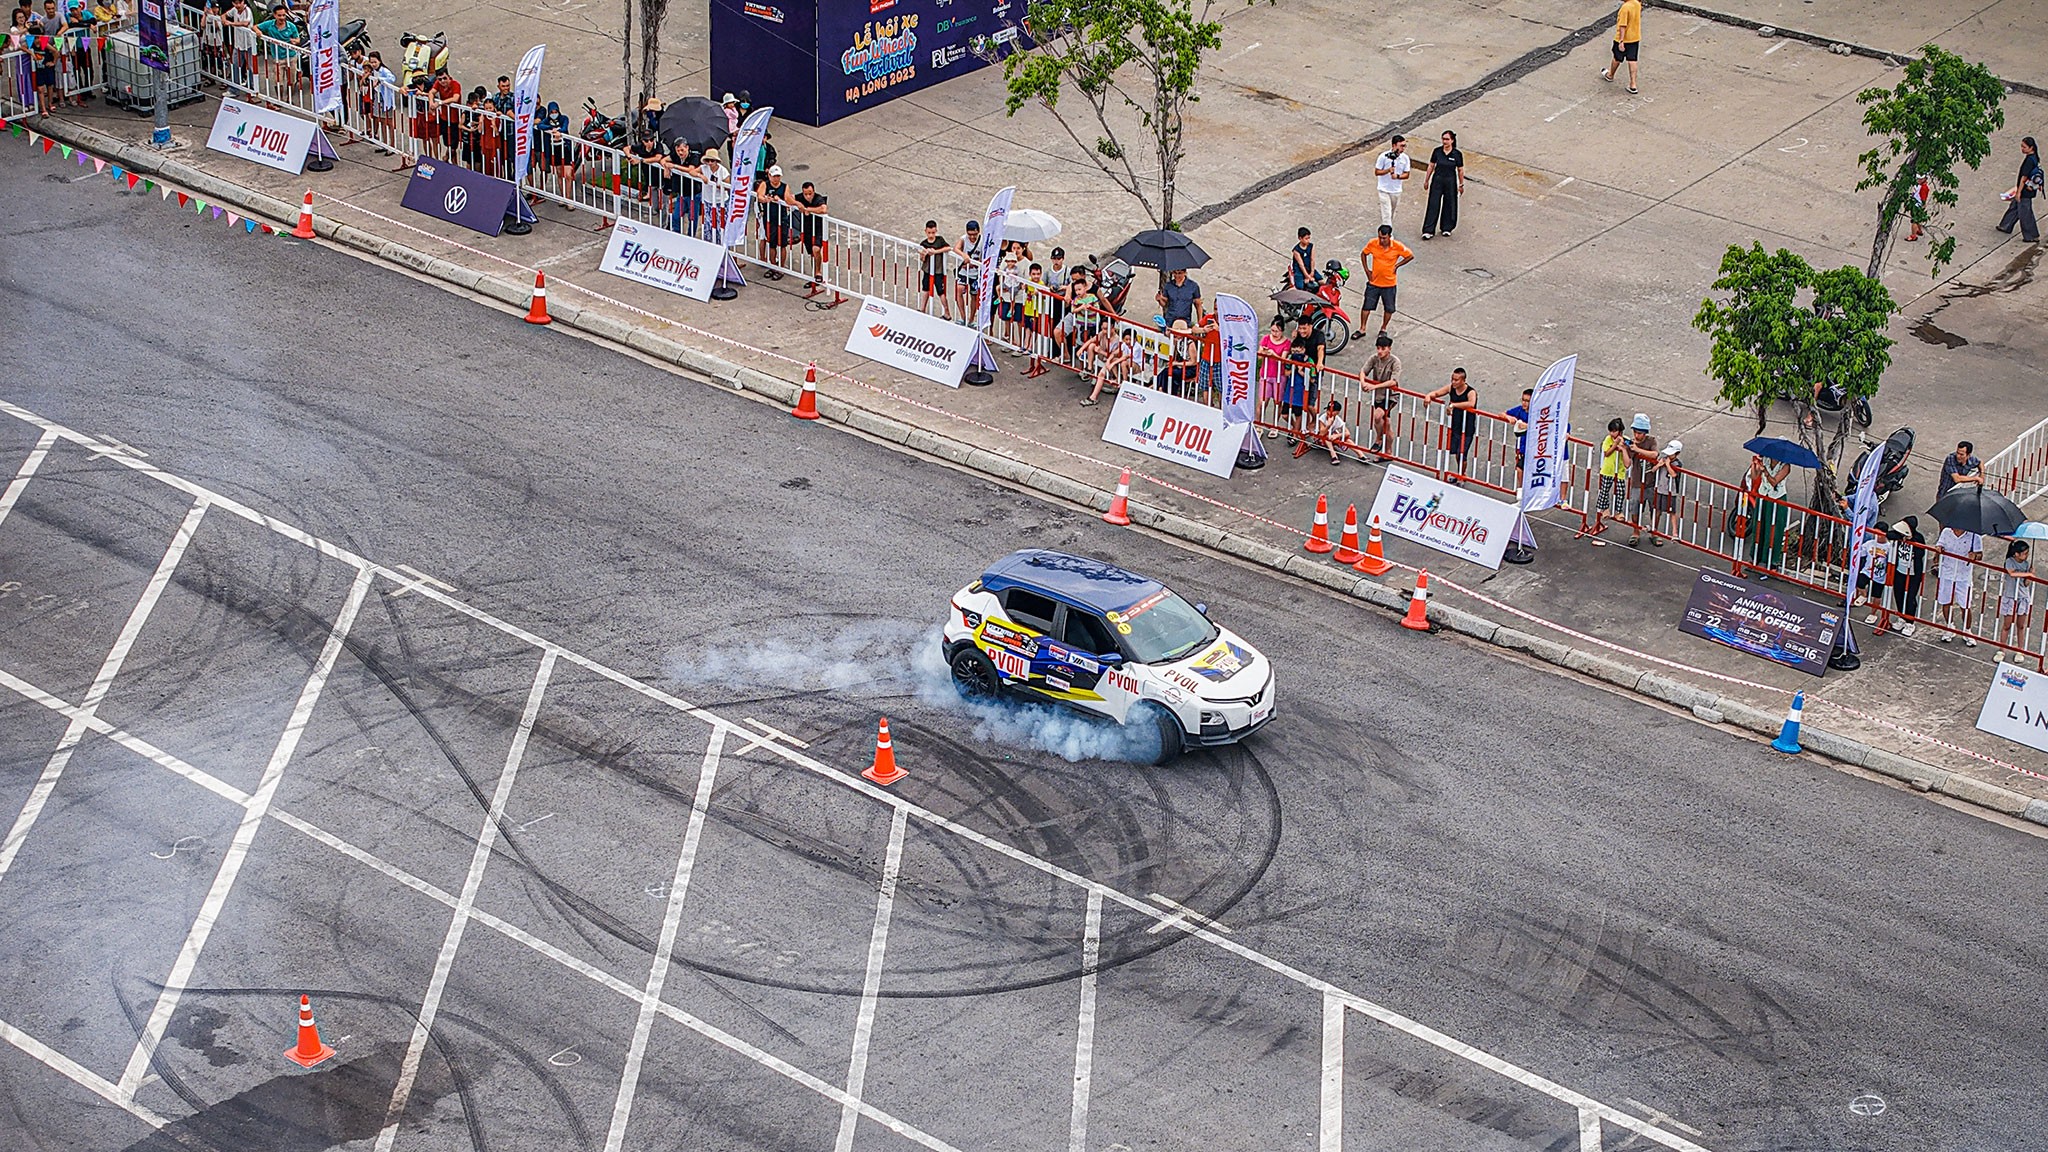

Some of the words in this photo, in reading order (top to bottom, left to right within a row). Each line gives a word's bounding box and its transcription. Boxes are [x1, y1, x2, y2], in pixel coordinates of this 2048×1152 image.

[843, 47, 869, 74] Fun
[870, 28, 917, 60] Wheels
[863, 48, 913, 81] Festival
[319, 47, 334, 94] PVOIL
[845, 86, 861, 103] HẠ
[862, 77, 888, 96] LONG
[249, 124, 290, 156] PVOIL
[620, 241, 700, 283] Ekokemika
[895, 347, 921, 362] driving
[920, 355, 950, 371] emotion
[1159, 416, 1213, 456] PVOIL
[1531, 405, 1554, 489] Ekokemika
[1391, 493, 1489, 546] Ekokemika
[1704, 615, 1722, 628] 22
[1730, 604, 1763, 624] MEGA
[1764, 613, 1803, 635] OFFER
[1735, 597, 1805, 625] ANNIVERSARY
[1758, 633, 1768, 644] 9
[988, 648, 1026, 679] PVOIL
[1804, 648, 1817, 661] 16
[1108, 670, 1139, 695] PVOIL
[1163, 669, 1200, 694] PVOIL
